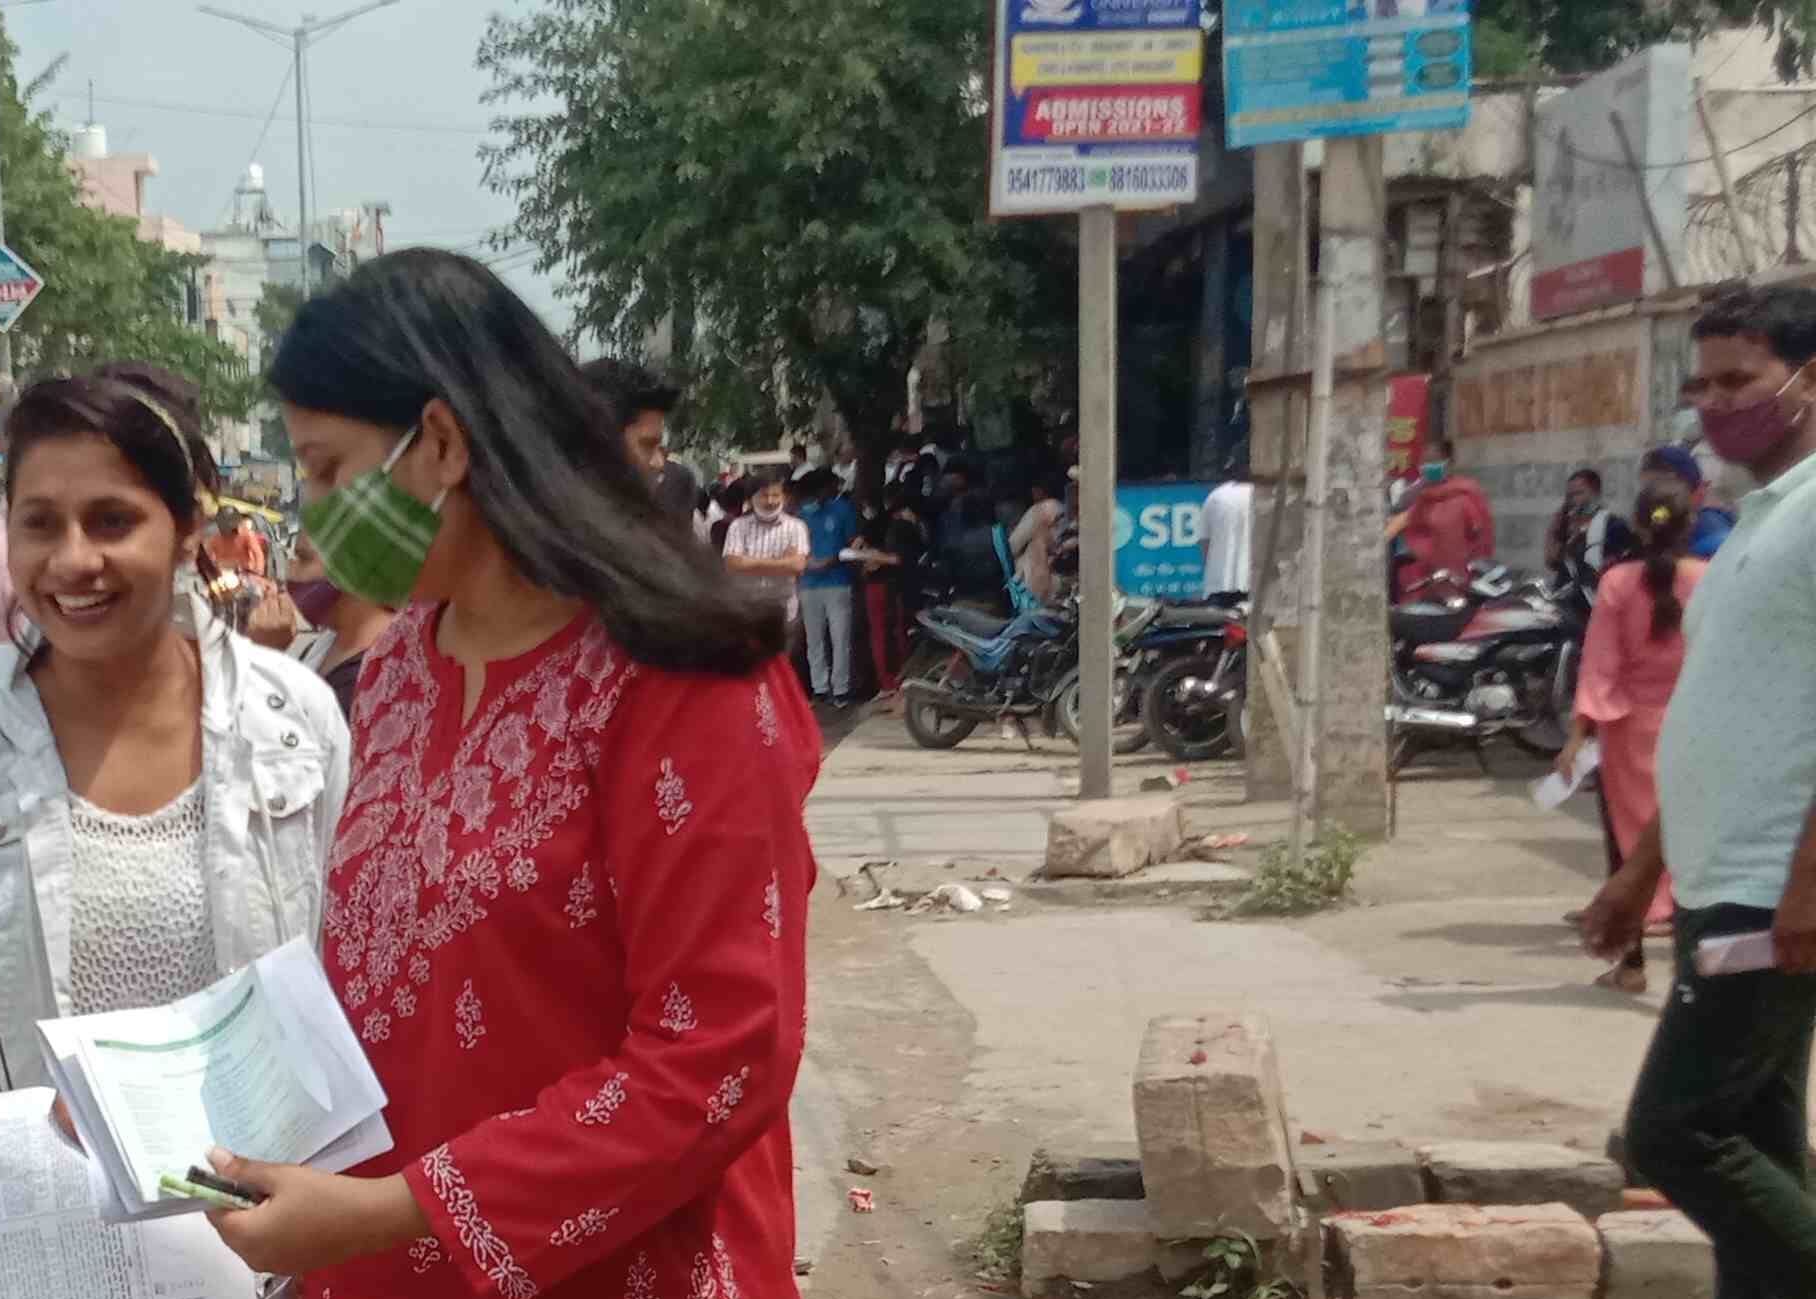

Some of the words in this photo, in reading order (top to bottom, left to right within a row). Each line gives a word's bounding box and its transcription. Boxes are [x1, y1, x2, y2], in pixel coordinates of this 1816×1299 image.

[1035, 96, 1186, 121] ADMISSIONS
[1052, 120, 1103, 136] OPEN
[1139, 503, 1203, 549] SB
